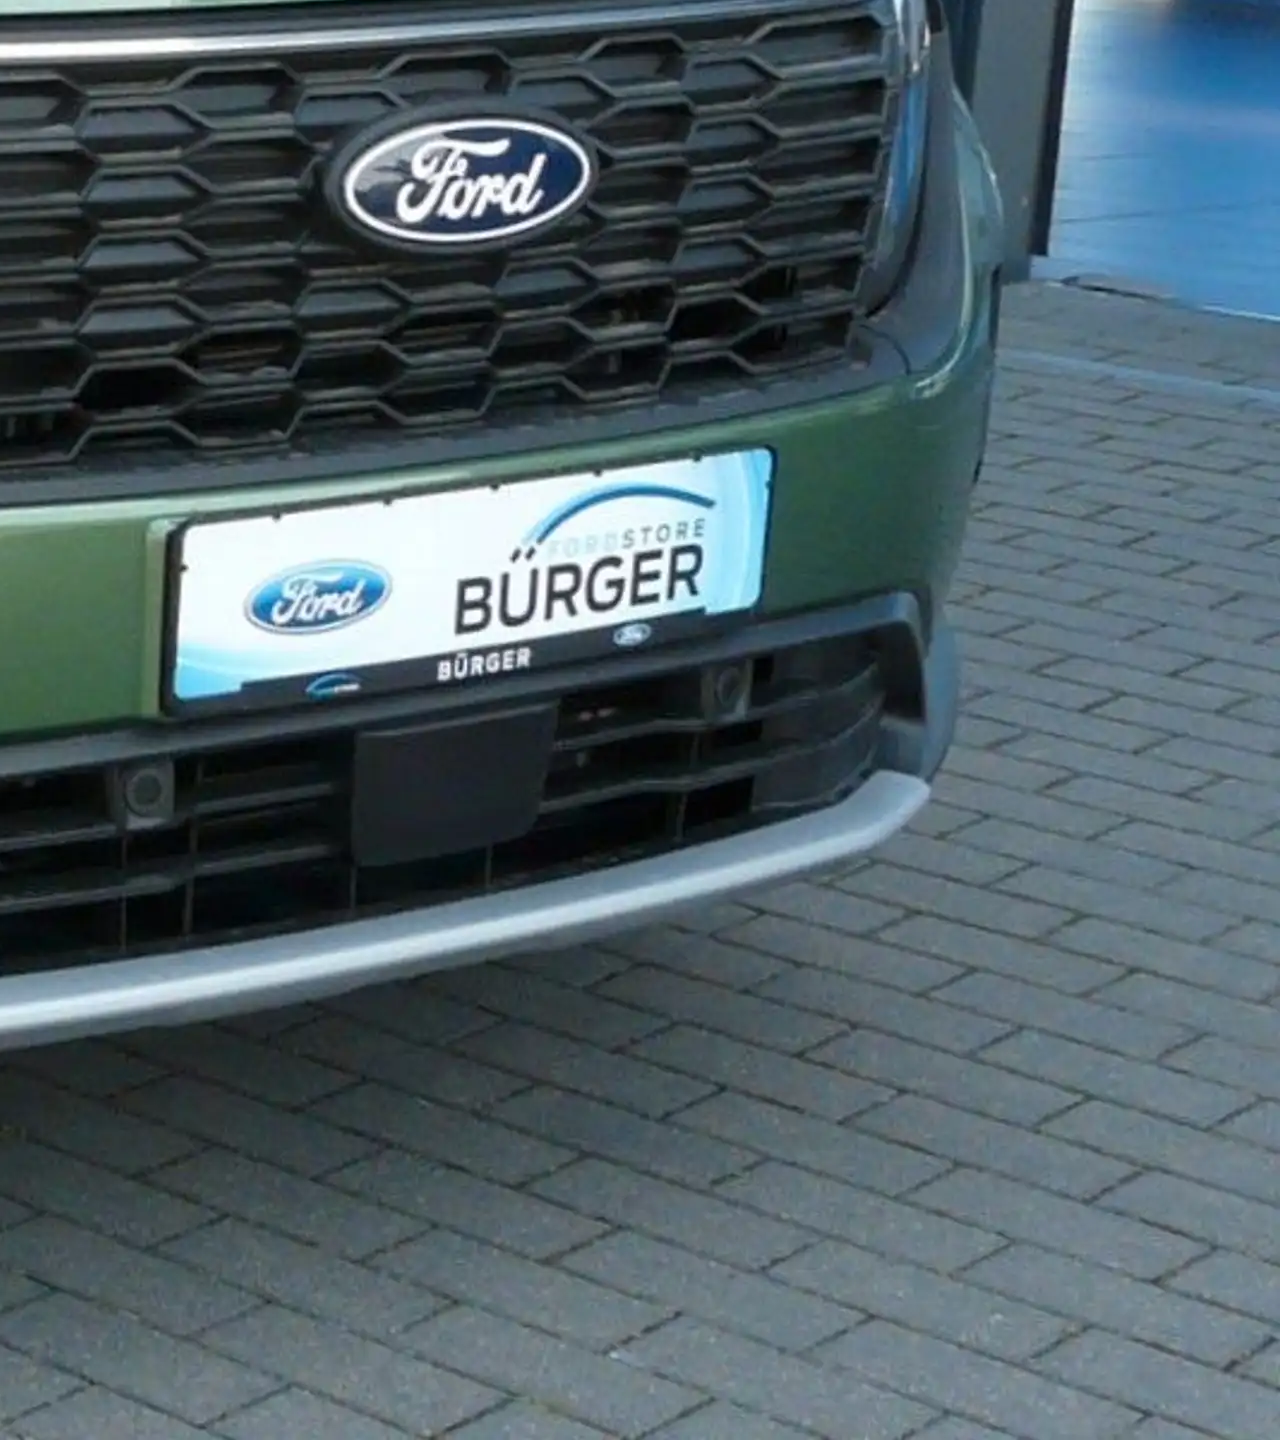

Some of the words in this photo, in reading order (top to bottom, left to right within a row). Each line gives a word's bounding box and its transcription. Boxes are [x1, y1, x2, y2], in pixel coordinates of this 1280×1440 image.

[396, 138, 547, 223] Ford
[271, 571, 368, 626] Ford
[454, 543, 704, 636] BÜRGER
[436, 647, 532, 682] BÜRGER
